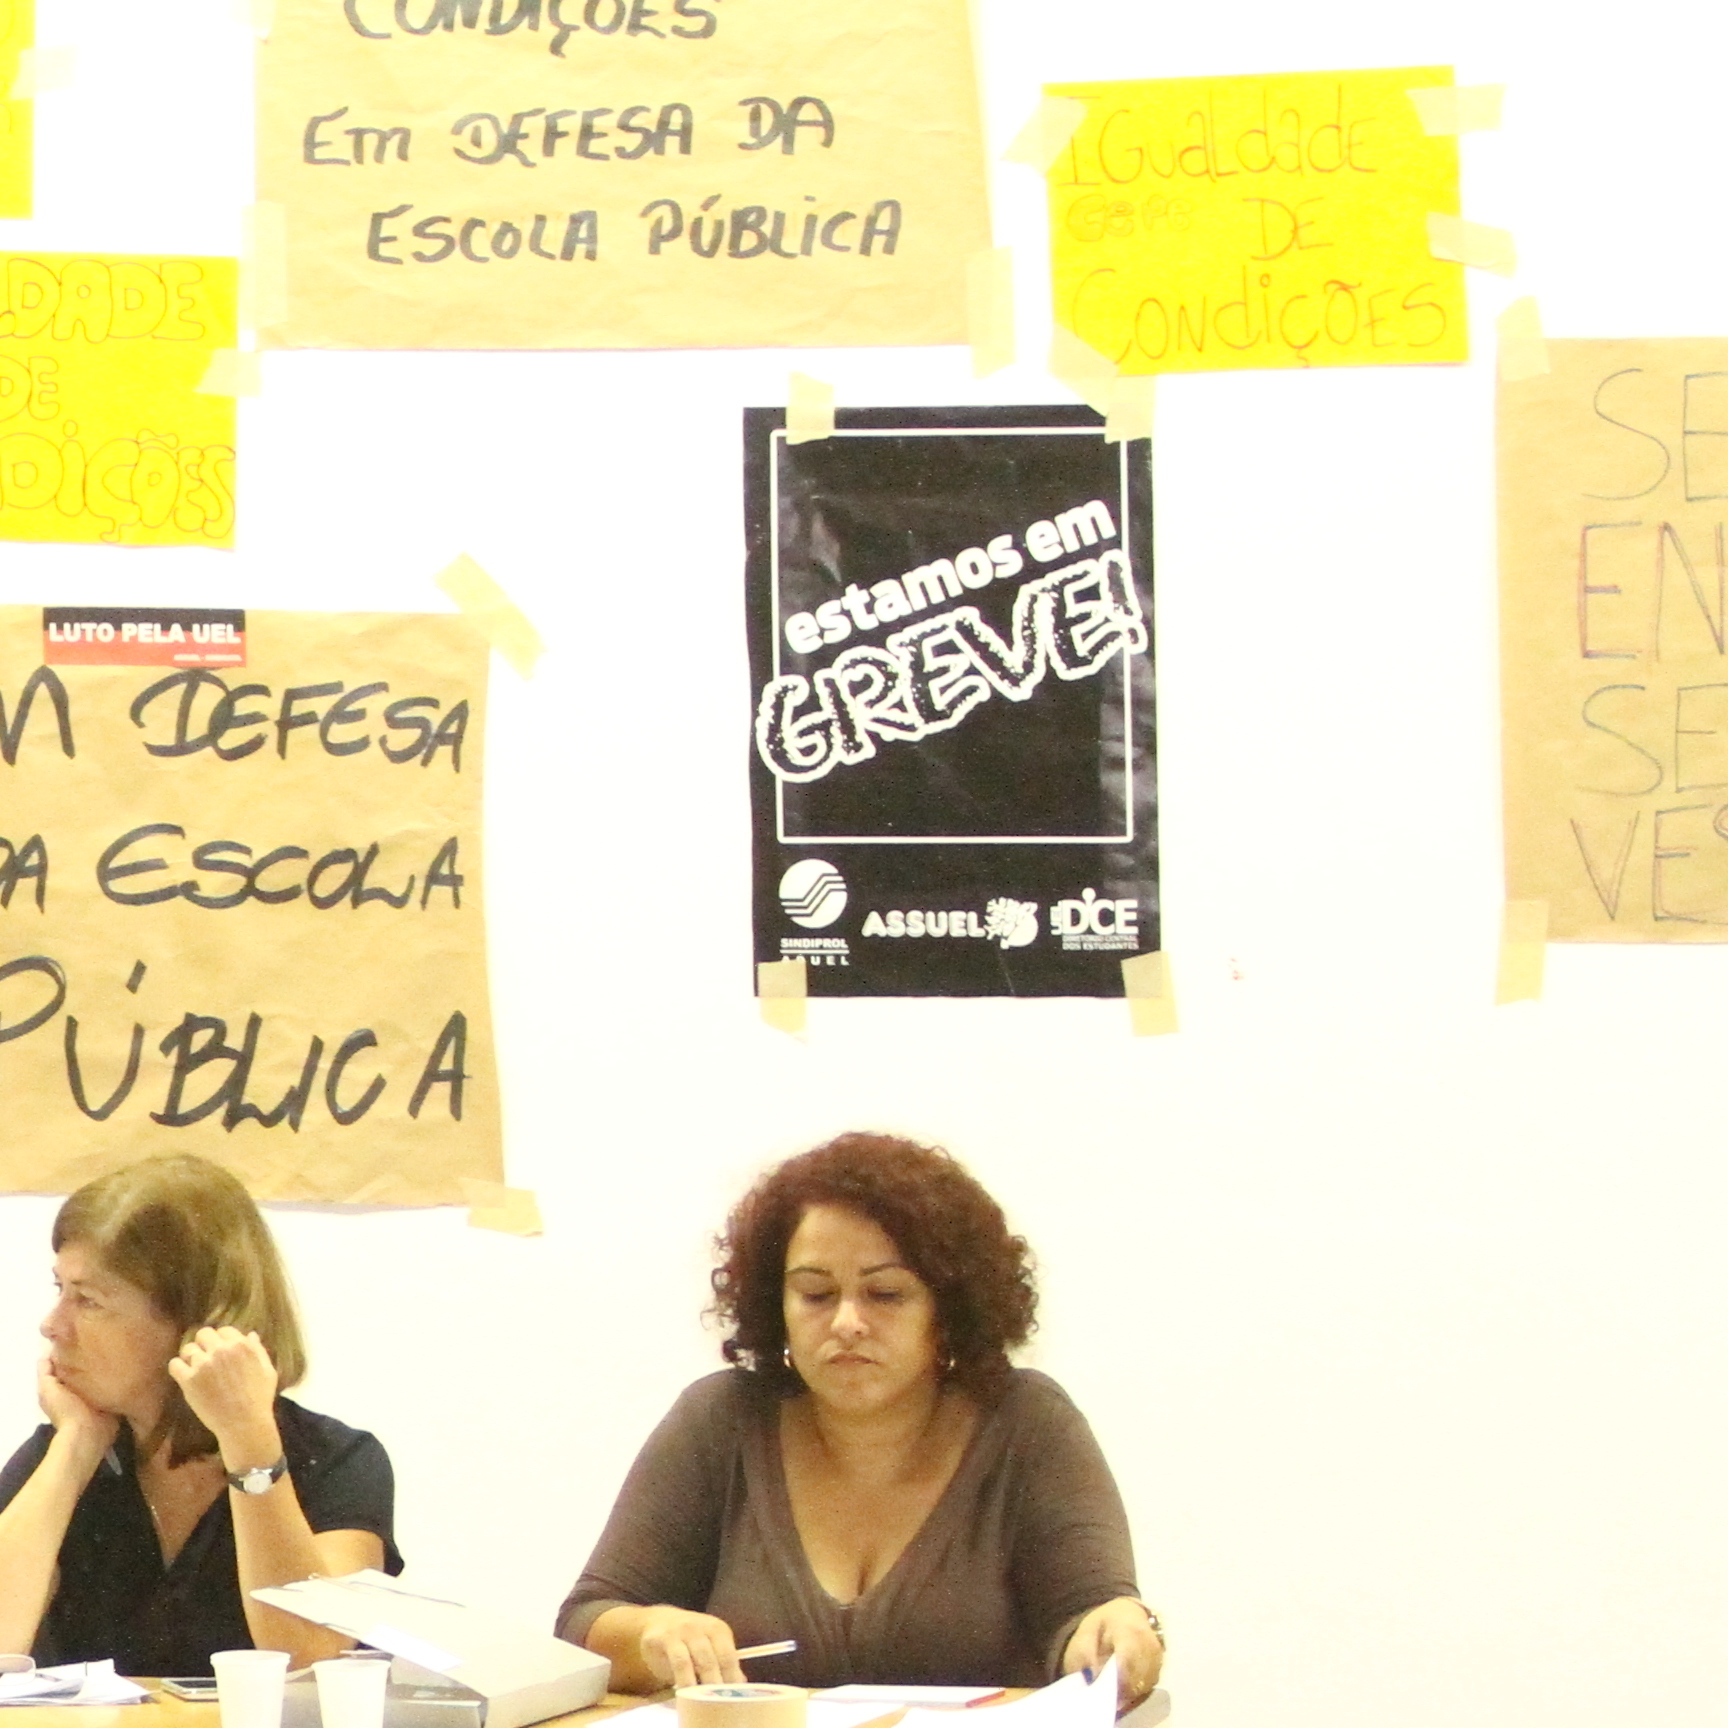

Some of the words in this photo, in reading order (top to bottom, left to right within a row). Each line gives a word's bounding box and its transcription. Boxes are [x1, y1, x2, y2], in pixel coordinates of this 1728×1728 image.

[450, 102, 694, 169] DEFESA
[737, 95, 836, 156] DA
[366, 203, 599, 266] ESCOLA
[638, 193, 903, 260] PÚBLICA
[1241, 196, 1334, 261] DE
[784, 533, 1024, 655] estamos
[1025, 499, 1117, 561] em
[48, 622, 115, 642] LUTO
[121, 622, 186, 643] PELA
[192, 623, 242, 644] UEL
[756, 548, 1149, 784] GREVE!
[129, 666, 471, 774] DEFESA
[97, 822, 466, 911] ESCOLA
[780, 937, 849, 948] SINDIPROL
[861, 910, 987, 939] ASSUEL
